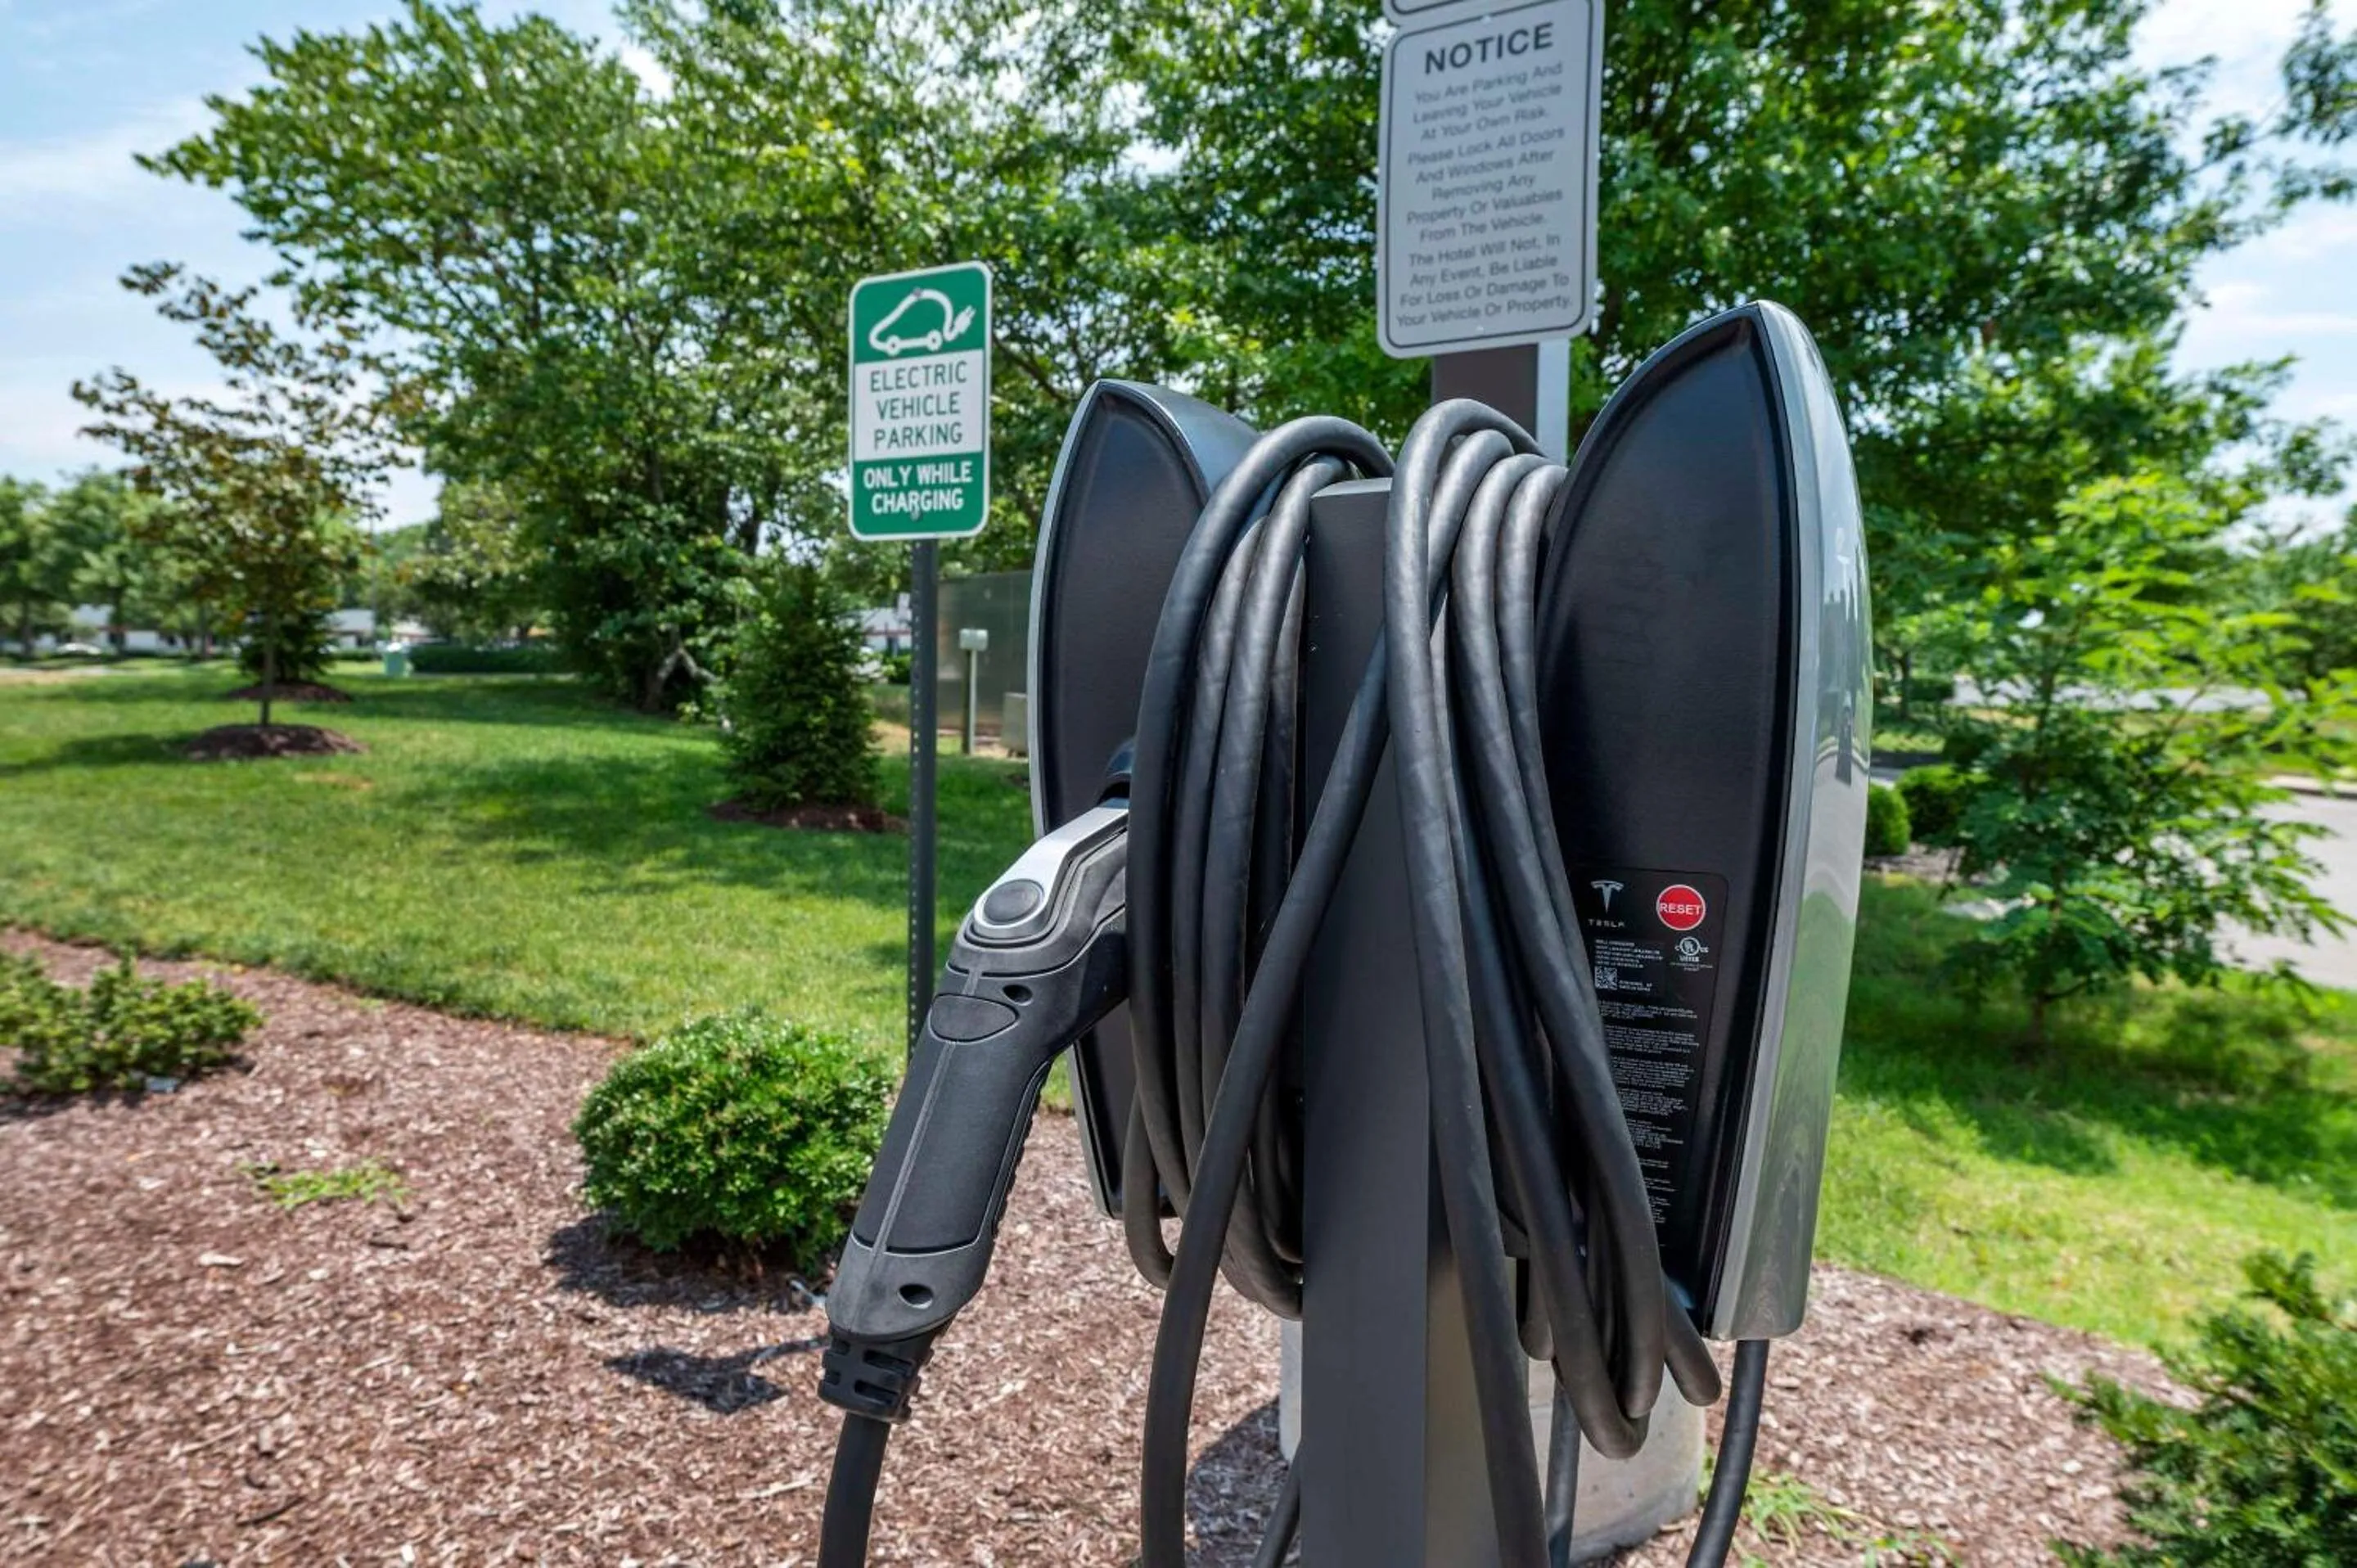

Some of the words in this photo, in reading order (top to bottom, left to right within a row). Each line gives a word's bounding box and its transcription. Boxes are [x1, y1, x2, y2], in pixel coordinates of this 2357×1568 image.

[1425, 22, 1553, 74] NOTICE
[1415, 90, 1440, 104] You
[1444, 85, 1468, 97] Are
[1472, 72, 1527, 92] Parking
[1532, 61, 1562, 79] And
[1413, 104, 1467, 124] Leaving
[1474, 97, 1503, 111] Your
[1509, 84, 1562, 103] Vehicle
[1421, 128, 1435, 142] At
[1442, 123, 1471, 137] Your
[1476, 115, 1510, 131] Own
[1408, 149, 1453, 165] Please
[1458, 139, 1491, 156] Lock
[1497, 135, 1516, 150] All
[1521, 127, 1565, 146] Doors
[1415, 169, 1444, 184] And
[1448, 157, 1513, 178] Windows
[1519, 150, 1554, 164] After
[1432, 179, 1503, 201] Removing
[1508, 174, 1535, 188] Any
[1407, 206, 1465, 224] Property
[1470, 201, 1487, 214] Or
[1493, 189, 1562, 210] Valuables
[1420, 228, 1455, 242] From
[1461, 223, 1486, 237] The
[1408, 253, 1433, 267] The
[1439, 247, 1476, 263] Hotel
[1480, 241, 1505, 256] Will
[1546, 233, 1560, 246] In
[1410, 273, 1435, 288] Any
[1489, 262, 1508, 276] Be
[1513, 256, 1557, 273] Liable
[1399, 294, 1422, 307] For
[1427, 290, 1459, 304] Loss
[1465, 286, 1482, 298] Or
[1487, 277, 1546, 296] Damage
[1553, 273, 1570, 286] To
[1396, 313, 1426, 327] Your
[1431, 307, 1480, 322] Vehicle
[1485, 303, 1502, 317] Or
[870, 360, 967, 393] ELECTRIC
[877, 392, 960, 420] VEHICLE
[874, 421, 962, 449] PARKING
[863, 466, 912, 489] ONLY
[917, 461, 972, 485] WHILE
[872, 489, 964, 515] CHARGING
[1588, 919, 1625, 927] TESLA
[1660, 903, 1701, 915] RESET
